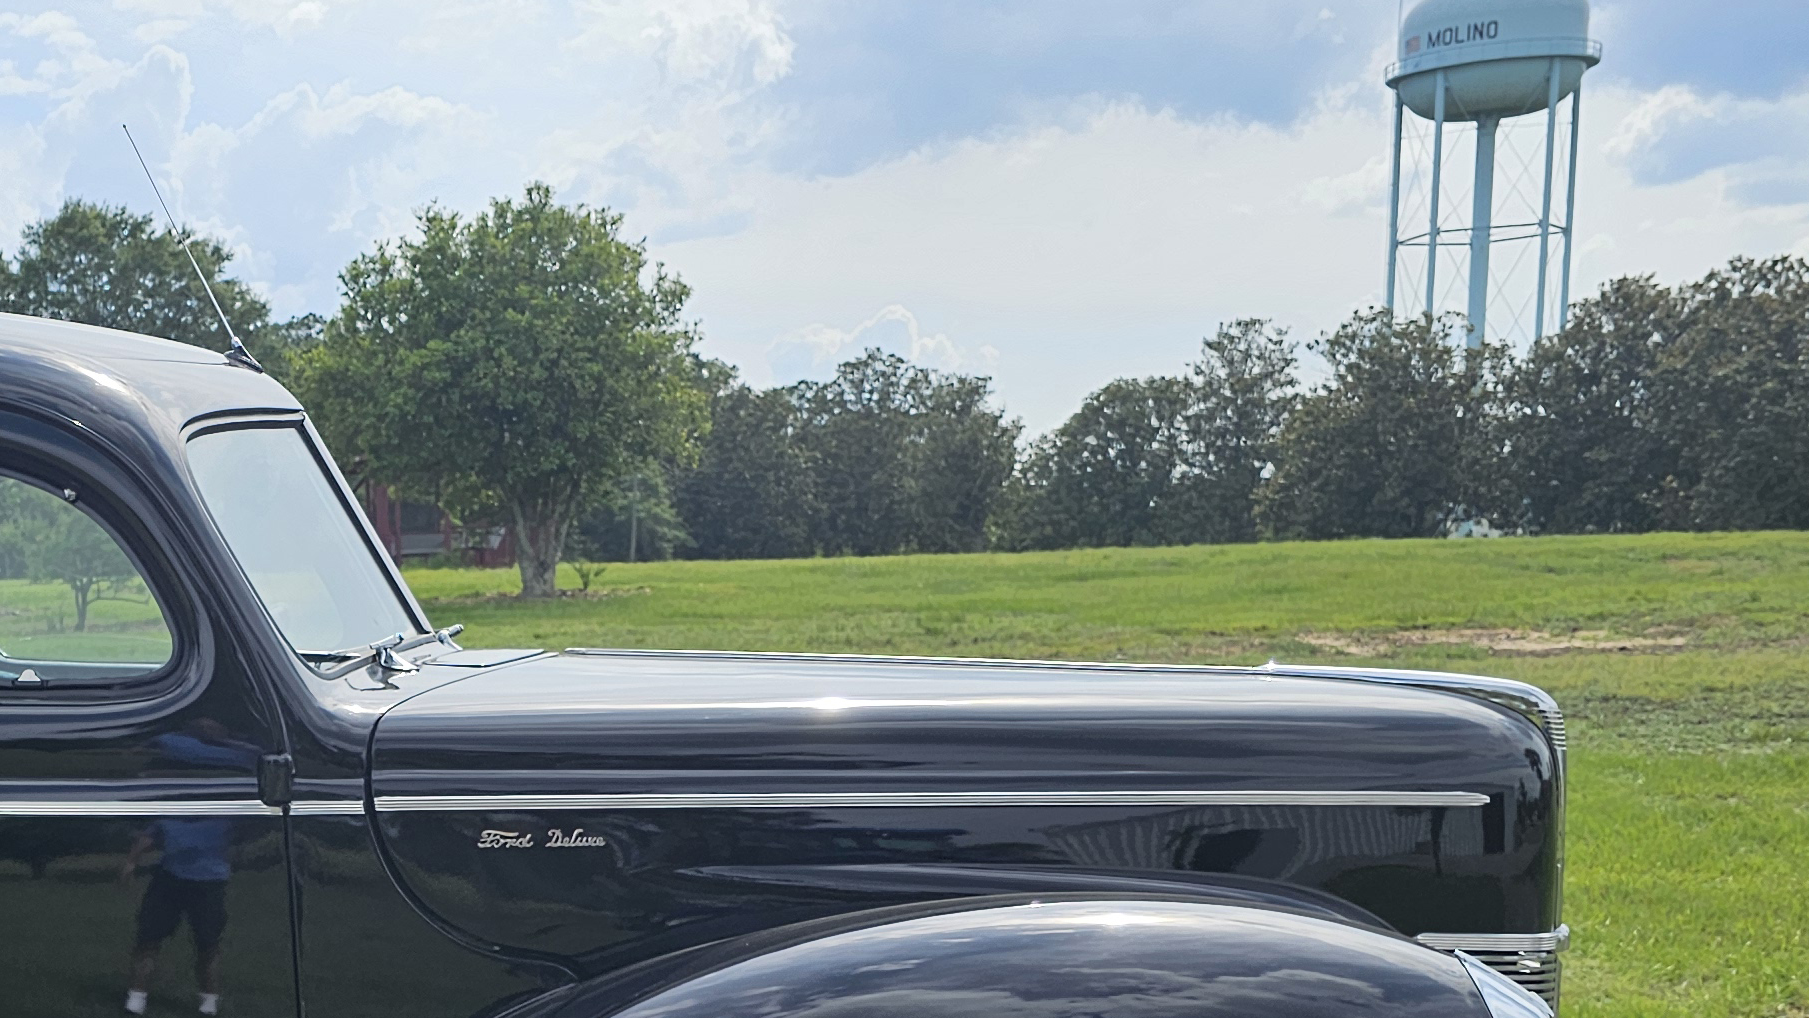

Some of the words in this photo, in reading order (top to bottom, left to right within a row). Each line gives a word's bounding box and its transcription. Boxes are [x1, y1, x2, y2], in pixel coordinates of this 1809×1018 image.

[1427, 20, 1499, 49] MOLINO
[477, 829, 534, 848] Ford
[544, 828, 606, 848] Deluxe
